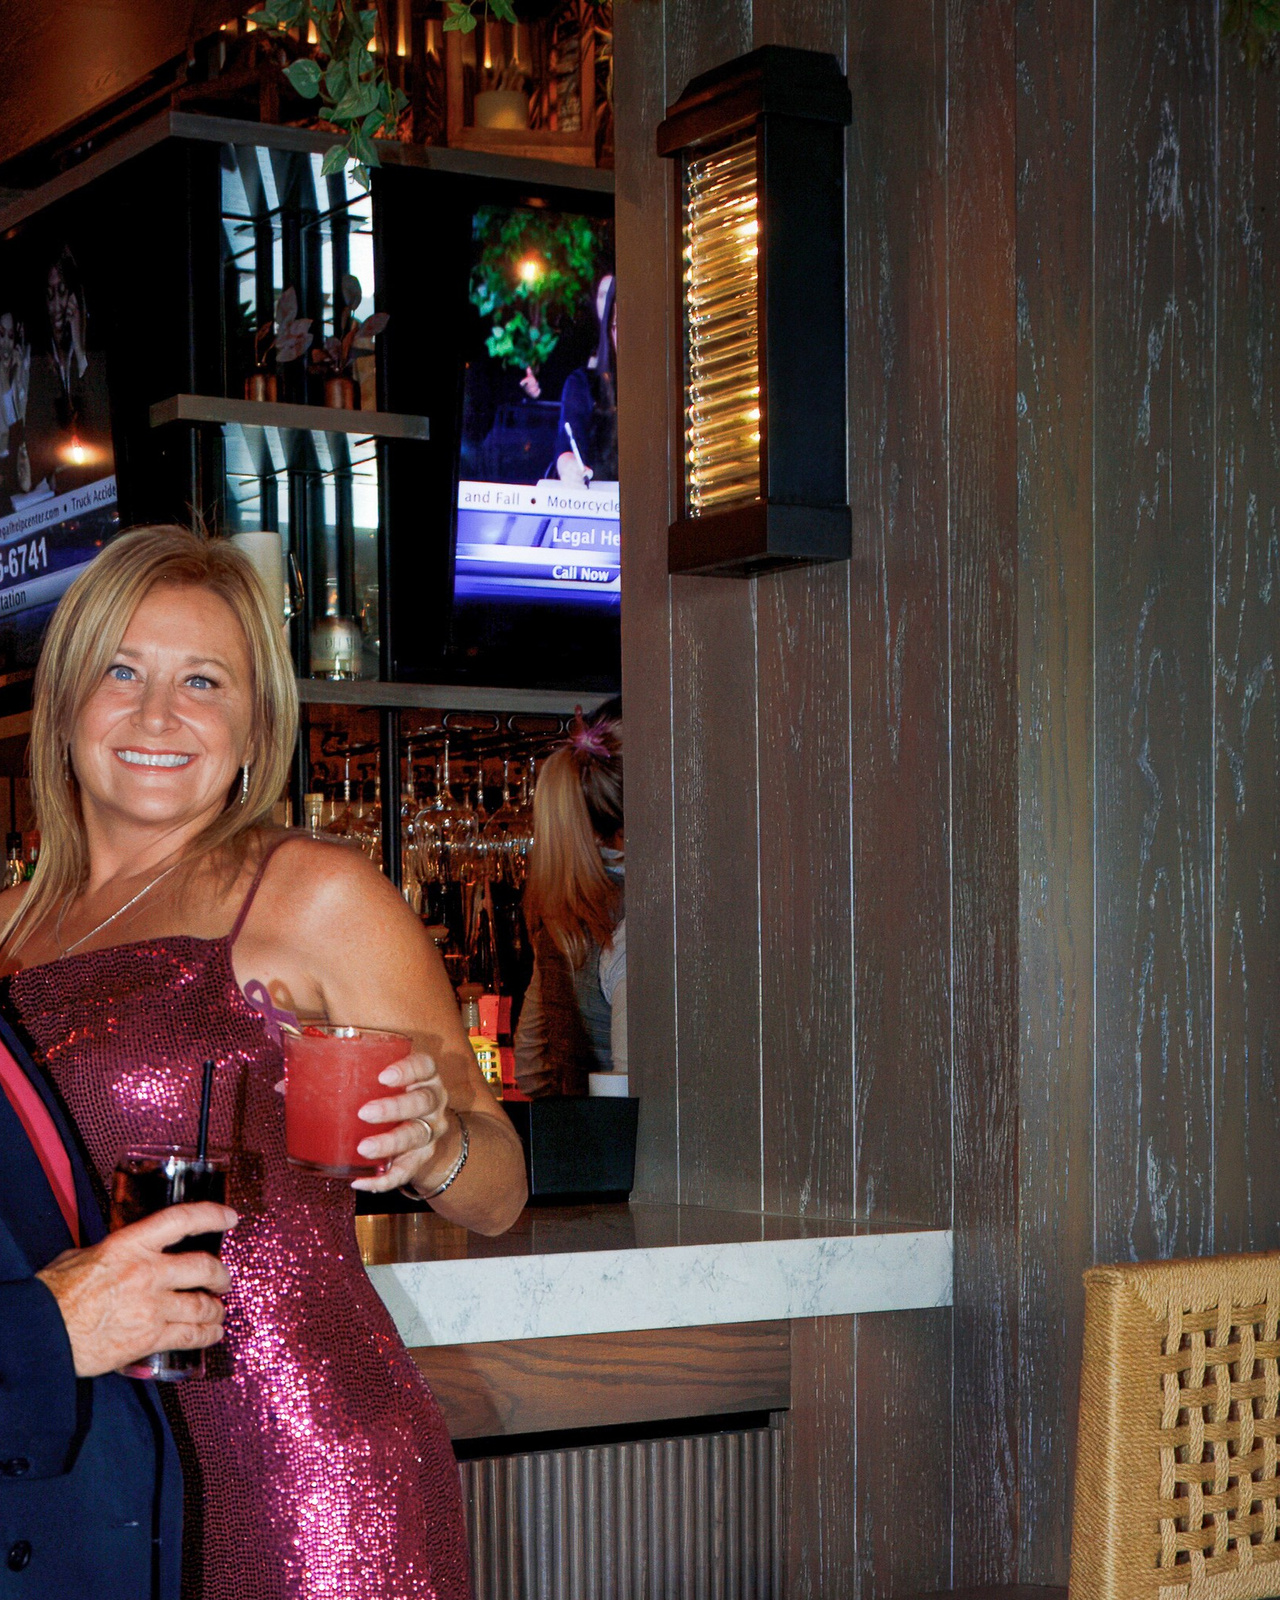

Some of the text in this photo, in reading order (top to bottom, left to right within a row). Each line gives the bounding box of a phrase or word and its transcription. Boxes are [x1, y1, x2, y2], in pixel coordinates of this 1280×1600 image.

[71, 492, 91, 511] Truck
[464, 491, 490, 504] and
[496, 492, 520, 506] Fall
[552, 527, 595, 547] Legal
[552, 564, 610, 582] Call Now
